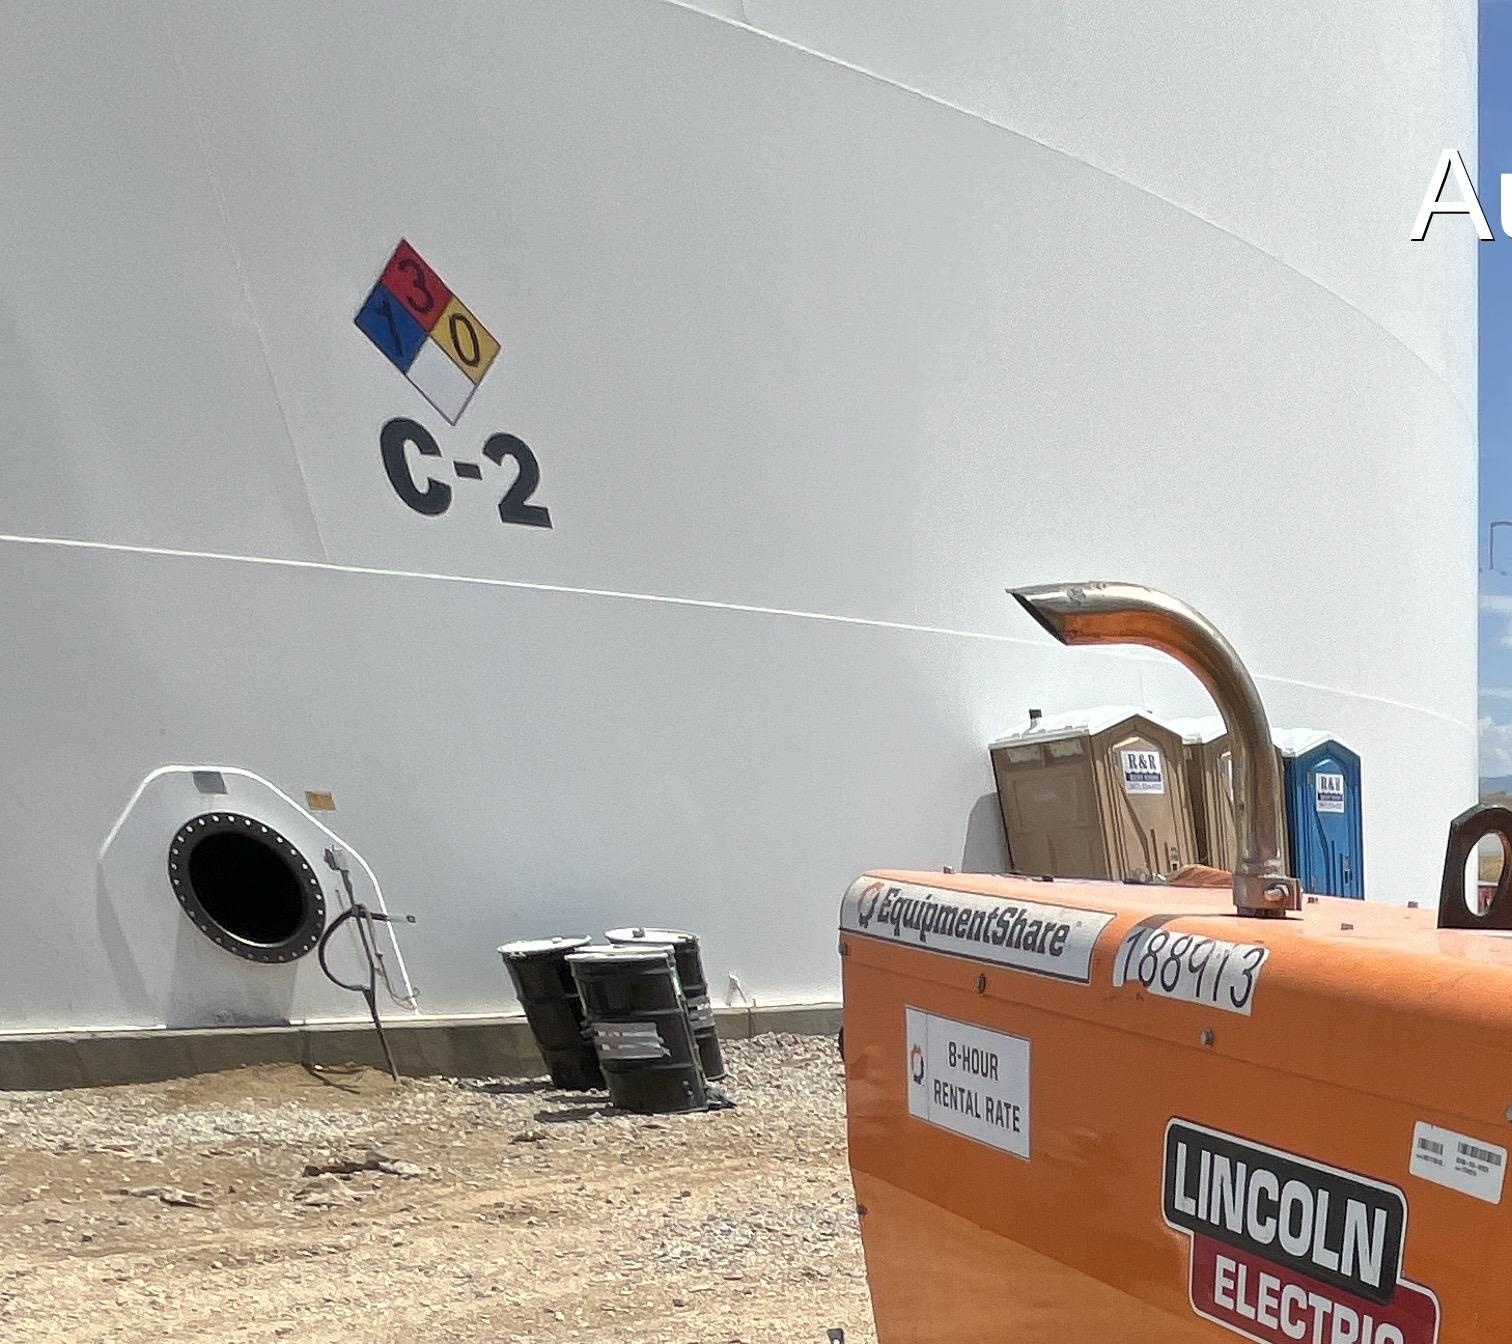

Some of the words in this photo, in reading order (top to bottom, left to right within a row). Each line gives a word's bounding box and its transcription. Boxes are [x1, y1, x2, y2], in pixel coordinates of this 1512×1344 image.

[398, 258, 434, 314] 3
[379, 416, 553, 530] C-2
[1128, 753, 1157, 770] R&R
[876, 887, 1072, 957] EquipmentShare
[1122, 926, 1266, 1009] 188913
[948, 1040, 999, 1082] 8-HOUR
[933, 1079, 982, 1119] RENTAL
[985, 1098, 1021, 1134] RATE
[1174, 1140, 1388, 1289] LINCOLN
